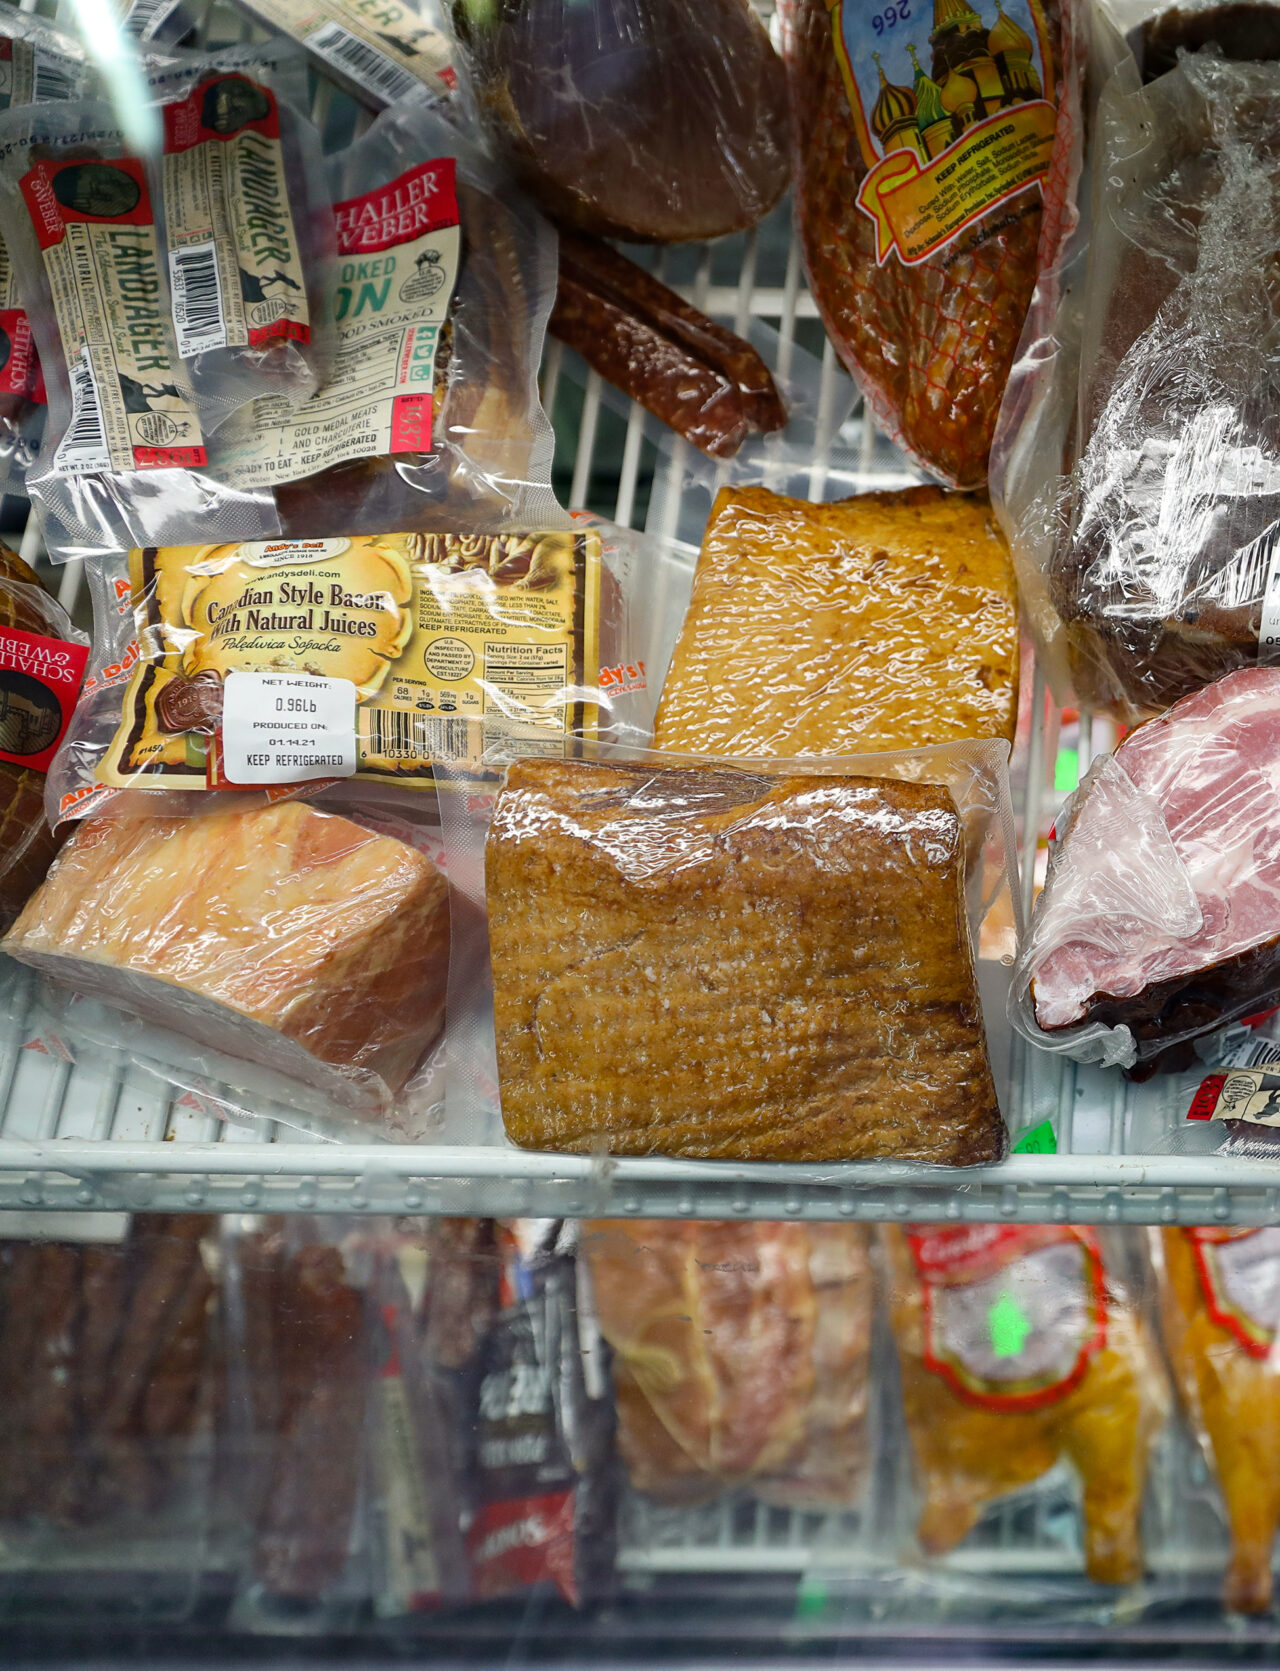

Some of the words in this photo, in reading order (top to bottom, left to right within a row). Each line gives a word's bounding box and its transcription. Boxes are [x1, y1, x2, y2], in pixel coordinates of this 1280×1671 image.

[935, 162, 957, 184] KEEP
[956, 124, 1016, 166] REFRIGERATED
[335, 171, 439, 232] HALLER
[936, 201, 961, 222] Sodium
[69, 224, 81, 241] ALL
[73, 244, 93, 287] NATURAL
[341, 255, 398, 284] OKED
[369, 307, 434, 332] SMOKED
[294, 425, 320, 438] GOLD
[322, 417, 349, 433] MEDAL
[351, 404, 378, 421] MEATS
[399, 404, 422, 449] 1937
[292, 437, 312, 450] AND
[314, 418, 372, 447] CHARCUTERIE
[264, 461, 276, 472] TO
[277, 458, 292, 471] EAT
[300, 451, 321, 466] KEEP
[322, 433, 377, 459] REFRIGERATED
[352, 444, 377, 454] 10028
[57, 464, 69, 472] NET
[263, 542, 299, 553] Andy's
[302, 541, 324, 550] Deli
[206, 585, 273, 625] Canadian
[279, 581, 324, 607] Style
[329, 583, 386, 612] Bacon
[209, 610, 242, 643] With
[245, 608, 314, 633] Natural
[318, 612, 378, 638] Juices
[443, 625, 507, 635] REFRIGERATED
[219, 635, 286, 653] Polędwica
[287, 635, 342, 656] Sopocka
[487, 645, 534, 654] Nutrition
[426, 657, 463, 665] DEPARTMENT
[261, 678, 284, 687] NET
[286, 680, 334, 690] WEIGHT:
[392, 676, 405, 684] PER
[404, 678, 427, 687] SERVING
[598, 663, 638, 686] dy's
[396, 687, 409, 695] 68
[274, 697, 318, 714] 0.96lb
[251, 720, 307, 731] PRODUCED
[309, 722, 329, 732] ON:
[267, 737, 317, 747] 01.14.21
[246, 753, 271, 767] KEEP
[275, 753, 344, 767] REFRIGERATED
